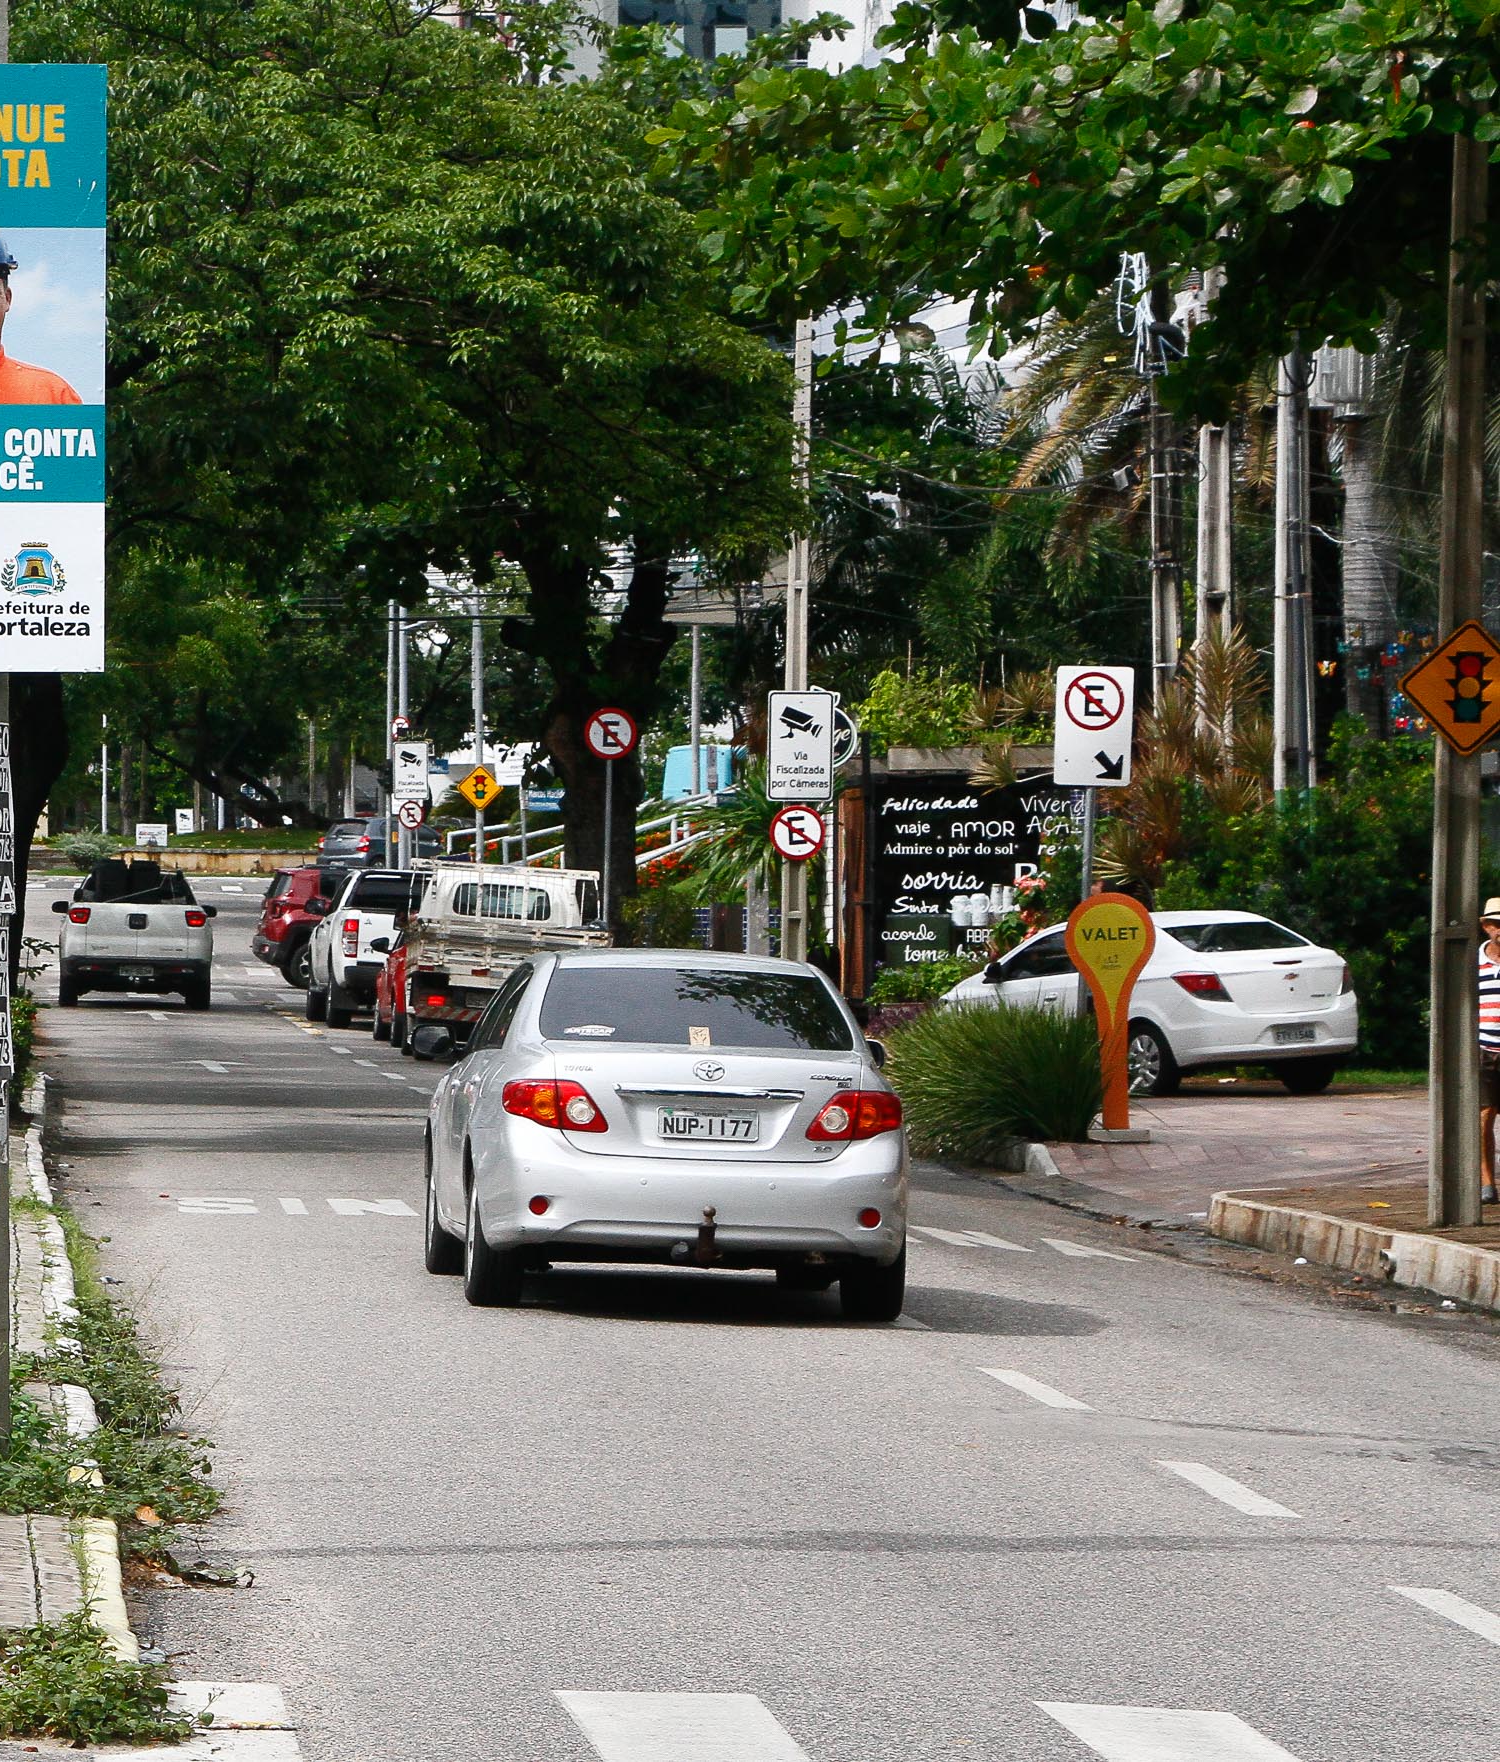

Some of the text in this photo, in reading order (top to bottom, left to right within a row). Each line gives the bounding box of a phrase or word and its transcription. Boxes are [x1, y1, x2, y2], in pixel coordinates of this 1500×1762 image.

[4, 428, 96, 457] CONTA
[68, 601, 90, 615] de
[1083, 685, 1105, 717] E
[603, 720, 620, 747] E
[793, 751, 808, 761] Via
[776, 765, 825, 775] Fiscalizada
[772, 781, 787, 790] por
[881, 796, 979, 815] felicidade
[1020, 795, 1071, 813] Viver
[787, 815, 807, 846] E
[895, 821, 1015, 838] viaje AMOR
[884, 843, 933, 855] Admire
[936, 846, 945, 855] o
[948, 842, 969, 858] pôr
[974, 842, 992, 855] do
[901, 870, 985, 891] sorria
[891, 895, 940, 914] Sinta
[881, 924, 937, 941] acorde
[1081, 927, 1139, 941] VALET
